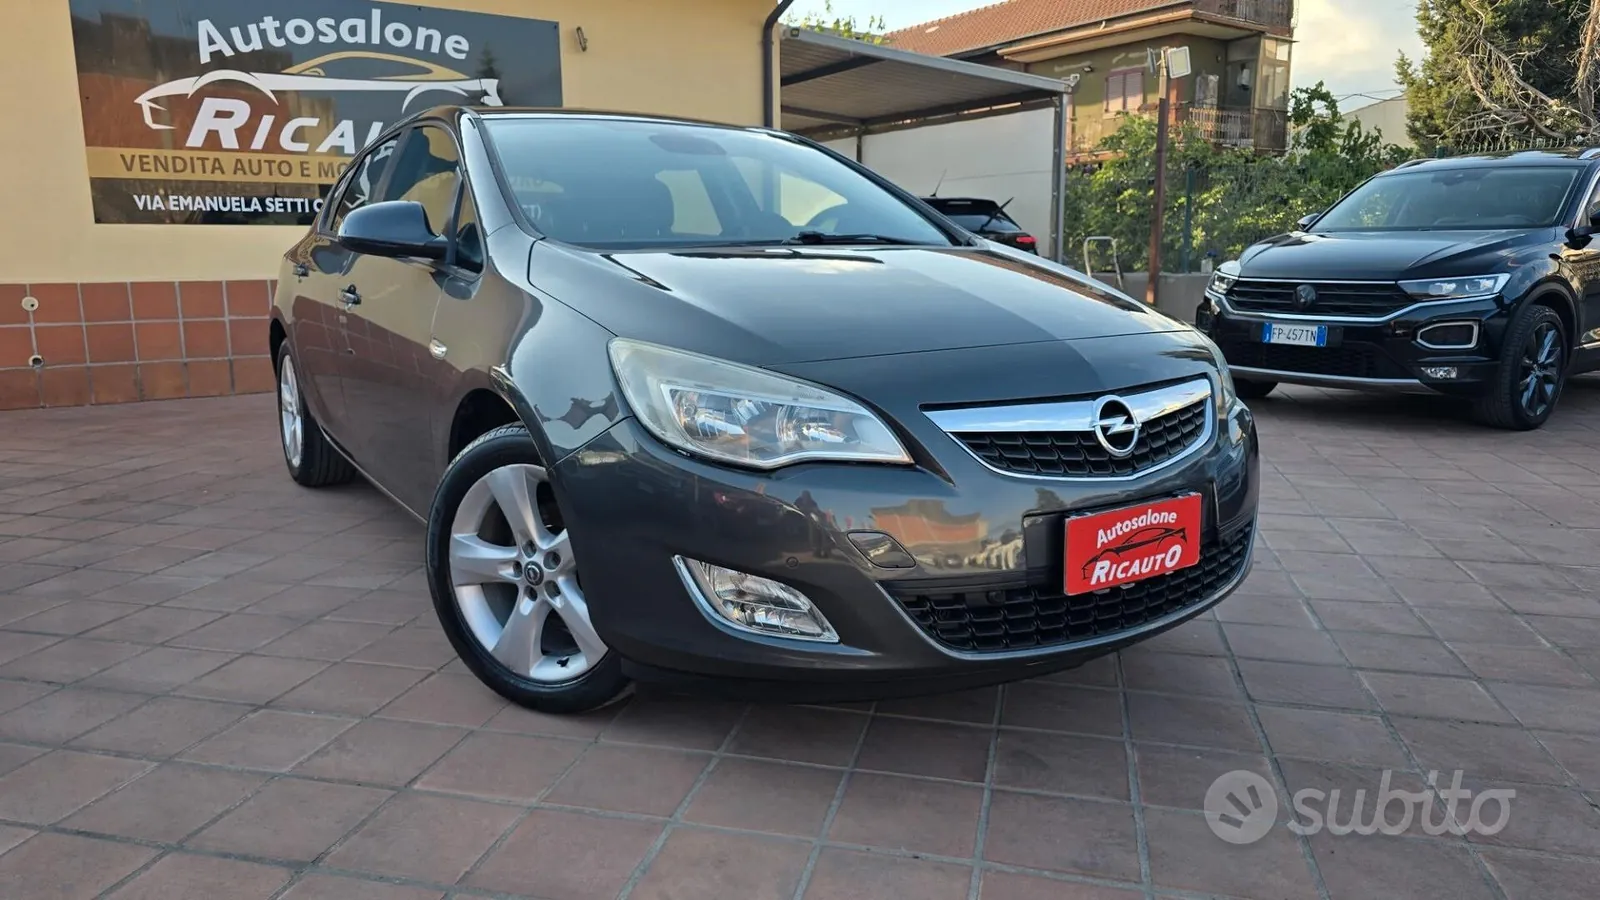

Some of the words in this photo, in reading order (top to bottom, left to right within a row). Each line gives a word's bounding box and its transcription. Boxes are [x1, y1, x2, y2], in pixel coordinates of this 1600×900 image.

[198, 8, 470, 64] Autosalone
[119, 153, 225, 175] VENDITA
[232, 157, 294, 178] AUTO
[300, 160, 311, 178] E
[133, 194, 166, 212] VIA
[169, 195, 263, 214] EMANUELA
[264, 197, 310, 214] SETTI
[1096, 509, 1178, 549] Autosalone
[1090, 544, 1182, 586] RICAUTO
